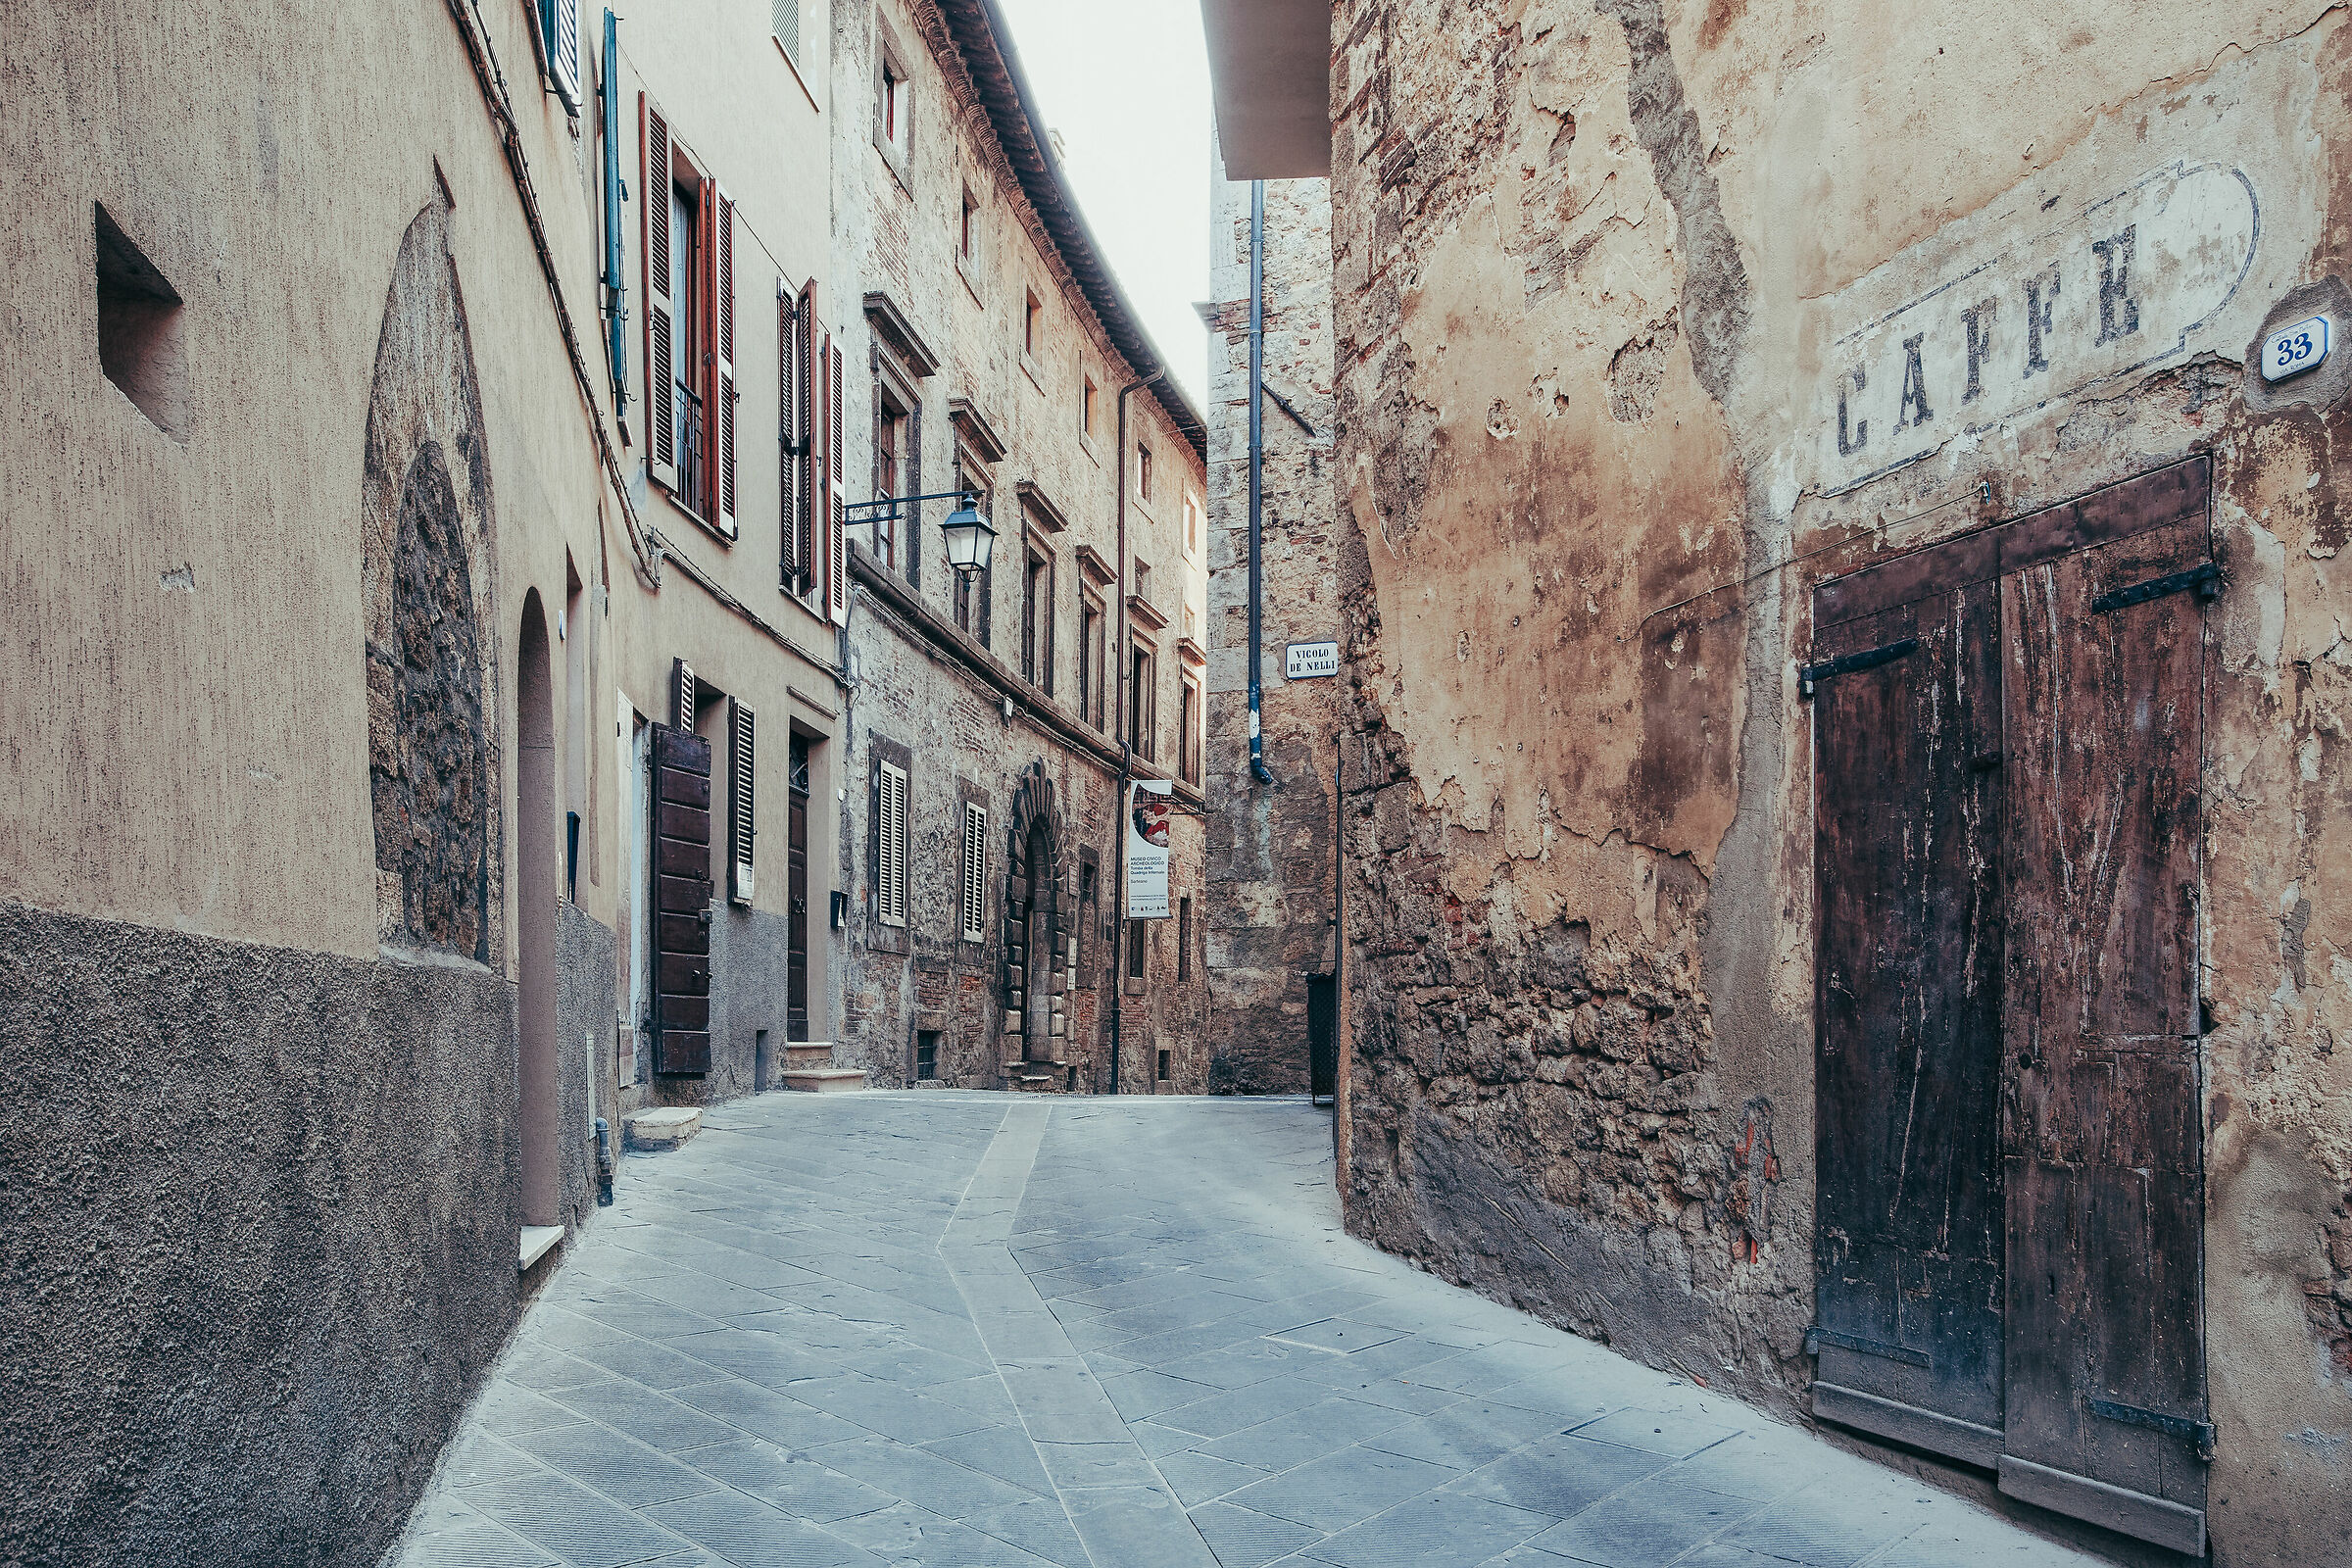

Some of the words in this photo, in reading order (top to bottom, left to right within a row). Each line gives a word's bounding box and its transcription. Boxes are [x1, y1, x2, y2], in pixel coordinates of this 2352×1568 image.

[2278, 332, 2313, 367] 33
[1296, 649, 1329, 659] VICOLO
[1306, 661, 1335, 671] NELLI
